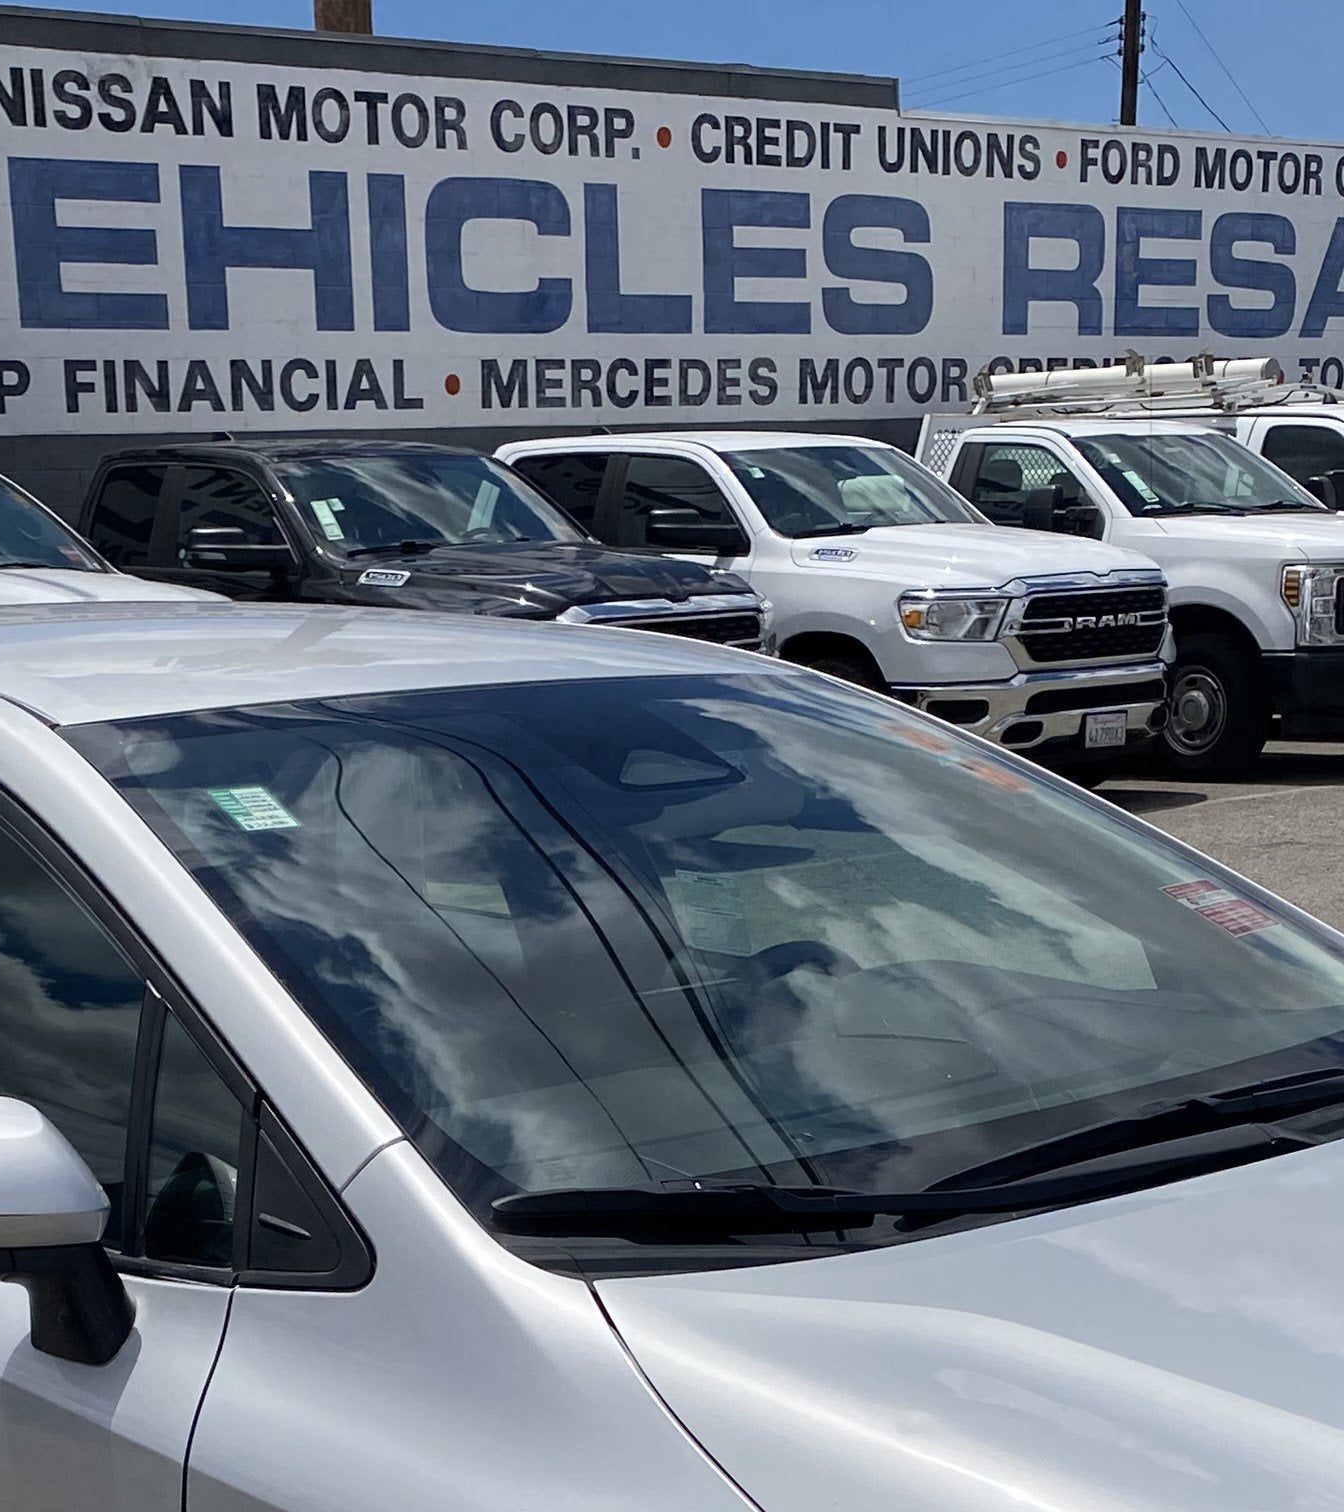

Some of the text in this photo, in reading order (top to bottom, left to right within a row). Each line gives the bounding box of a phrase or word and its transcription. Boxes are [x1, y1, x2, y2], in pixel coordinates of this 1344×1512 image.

[257, 83, 467, 151] MOTOR
[490, 98, 642, 160] CORP.
[691, 112, 1042, 181] CREDIT UNIONS
[1080, 137, 1181, 189] FORD
[1194, 146, 1323, 197] MOTOR
[63, 357, 425, 414] FINANCIAL
[479, 356, 968, 410] MERCEDES MOTOR
[1075, 613, 1136, 630] RAM
